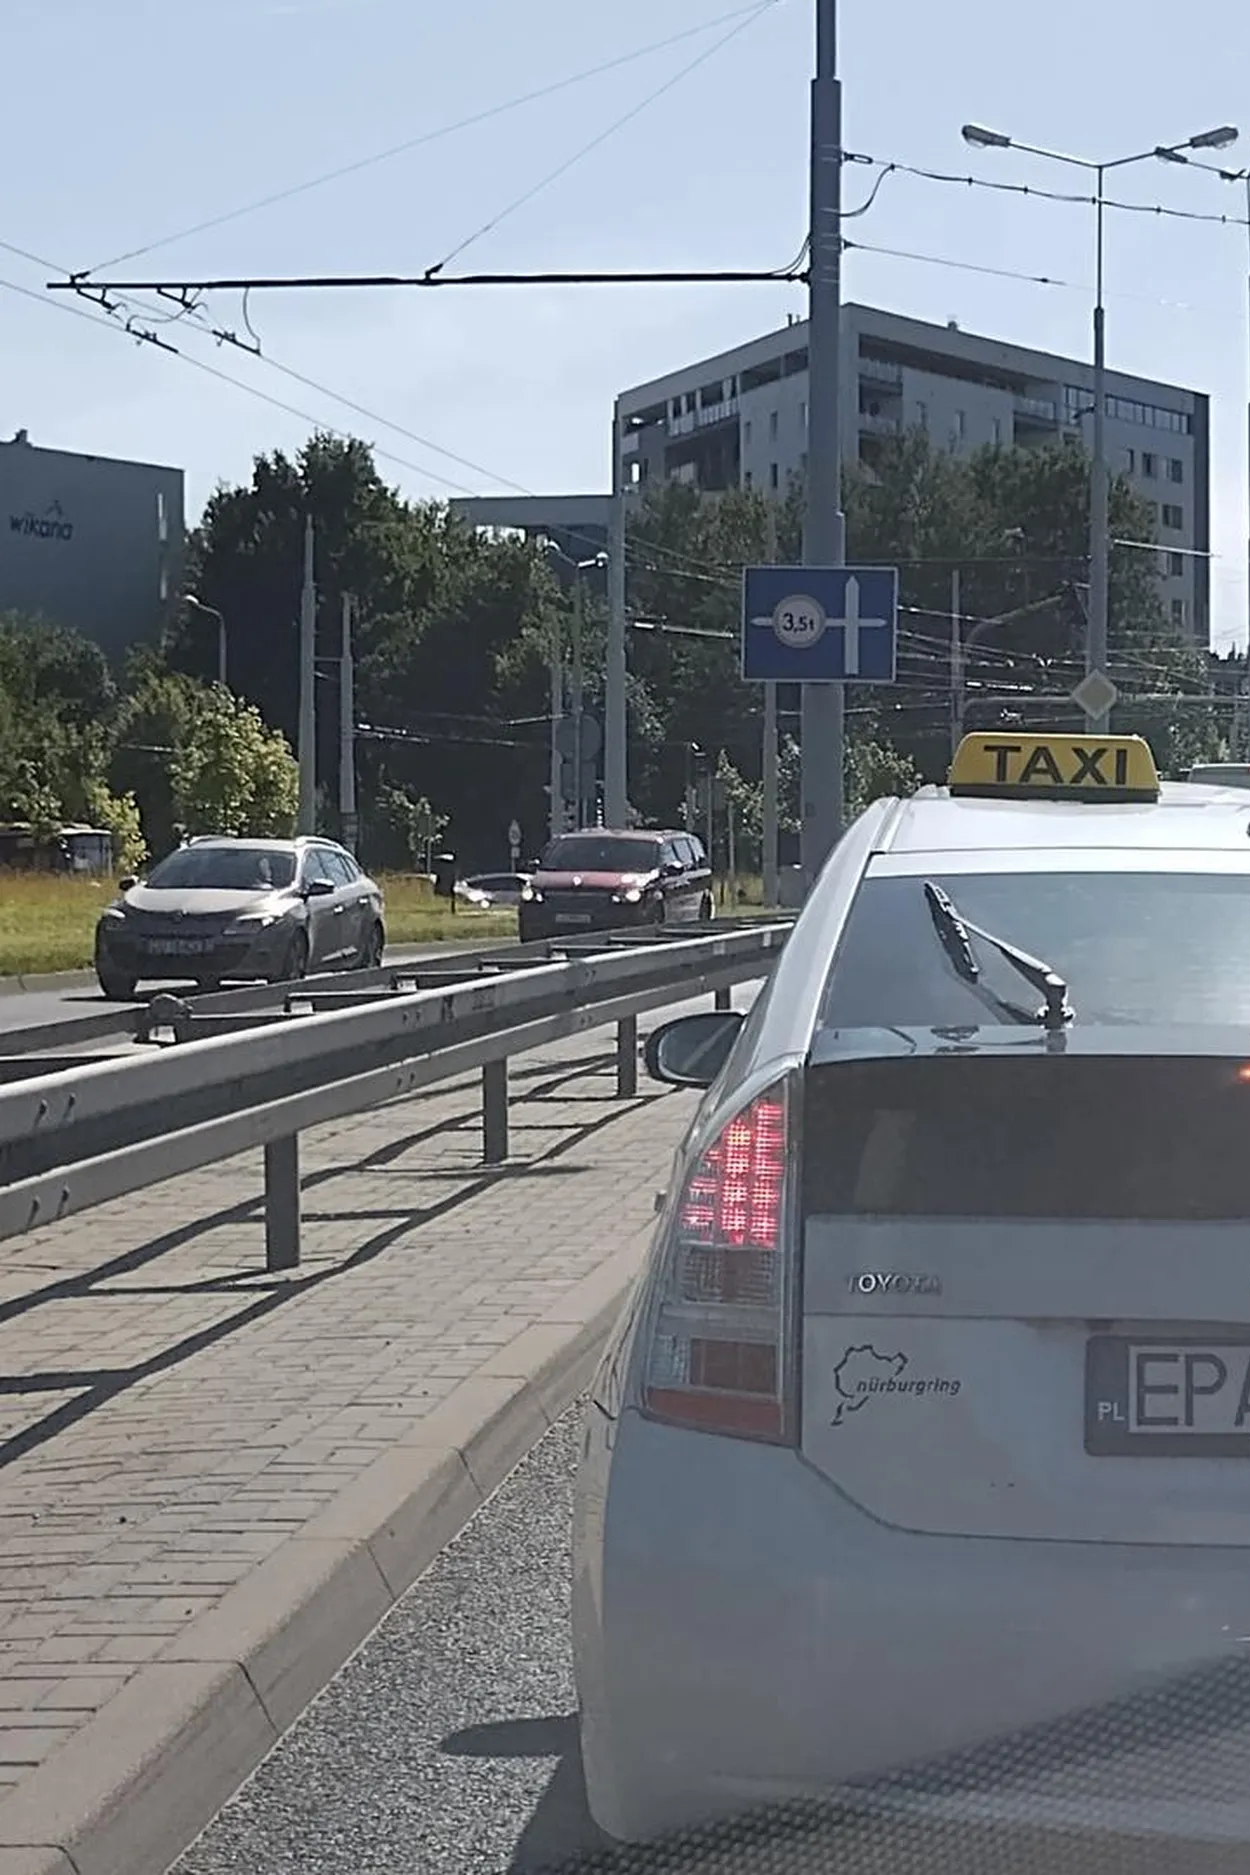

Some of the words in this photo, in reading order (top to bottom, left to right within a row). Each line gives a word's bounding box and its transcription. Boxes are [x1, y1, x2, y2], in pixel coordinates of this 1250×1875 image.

[984, 745, 1127, 785] TAXI
[848, 1273, 942, 1295] TOYOTA
[857, 1378, 961, 1396] nürburgring
[1098, 1402, 1126, 1421] PL
